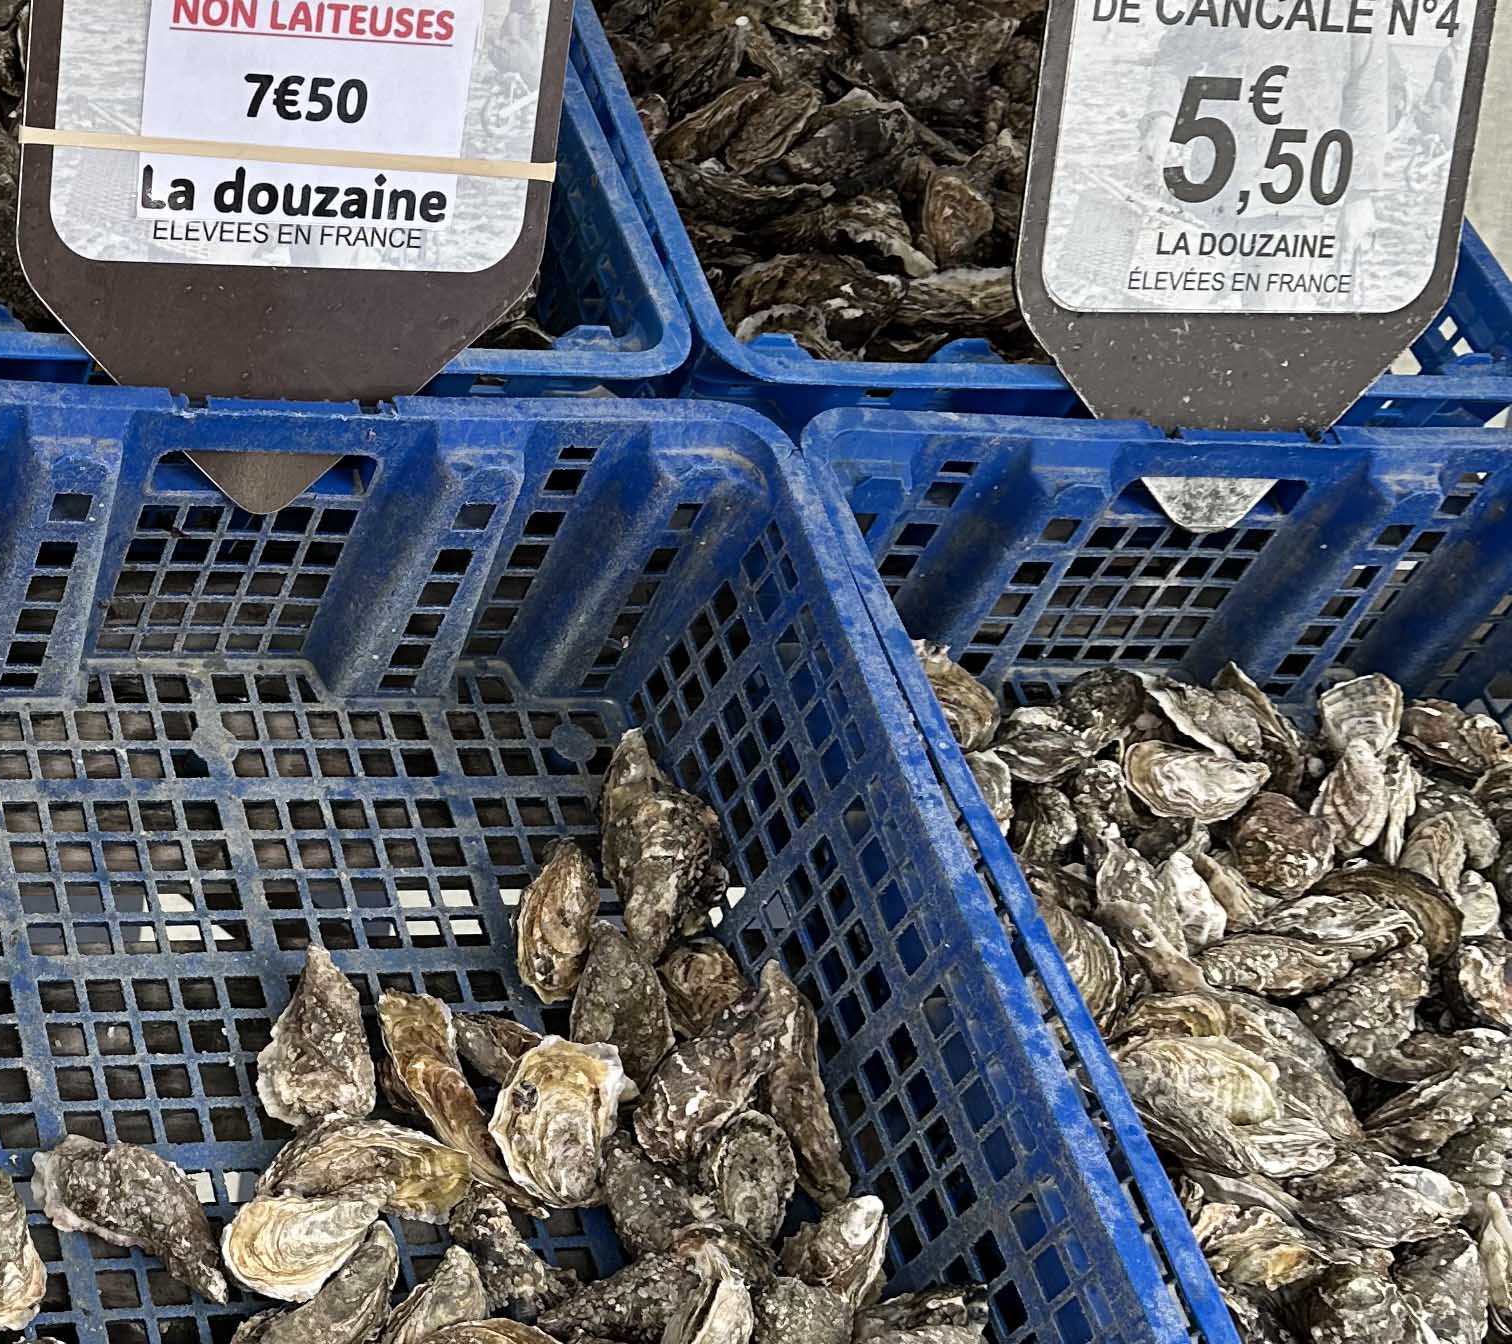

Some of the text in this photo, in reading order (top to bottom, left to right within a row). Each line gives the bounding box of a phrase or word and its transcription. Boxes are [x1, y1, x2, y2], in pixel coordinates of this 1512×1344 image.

[268, 0, 455, 40] LAITEUSES
[244, 74, 367, 123] 7€50
[141, 164, 446, 223] La douzaine
[278, 224, 312, 245] EN
[320, 226, 423, 248] FRANCE
[1156, 232, 1336, 258] LA DOUZAINE
[1128, 267, 1352, 293] ÉLEVÉES EN FRANCE
